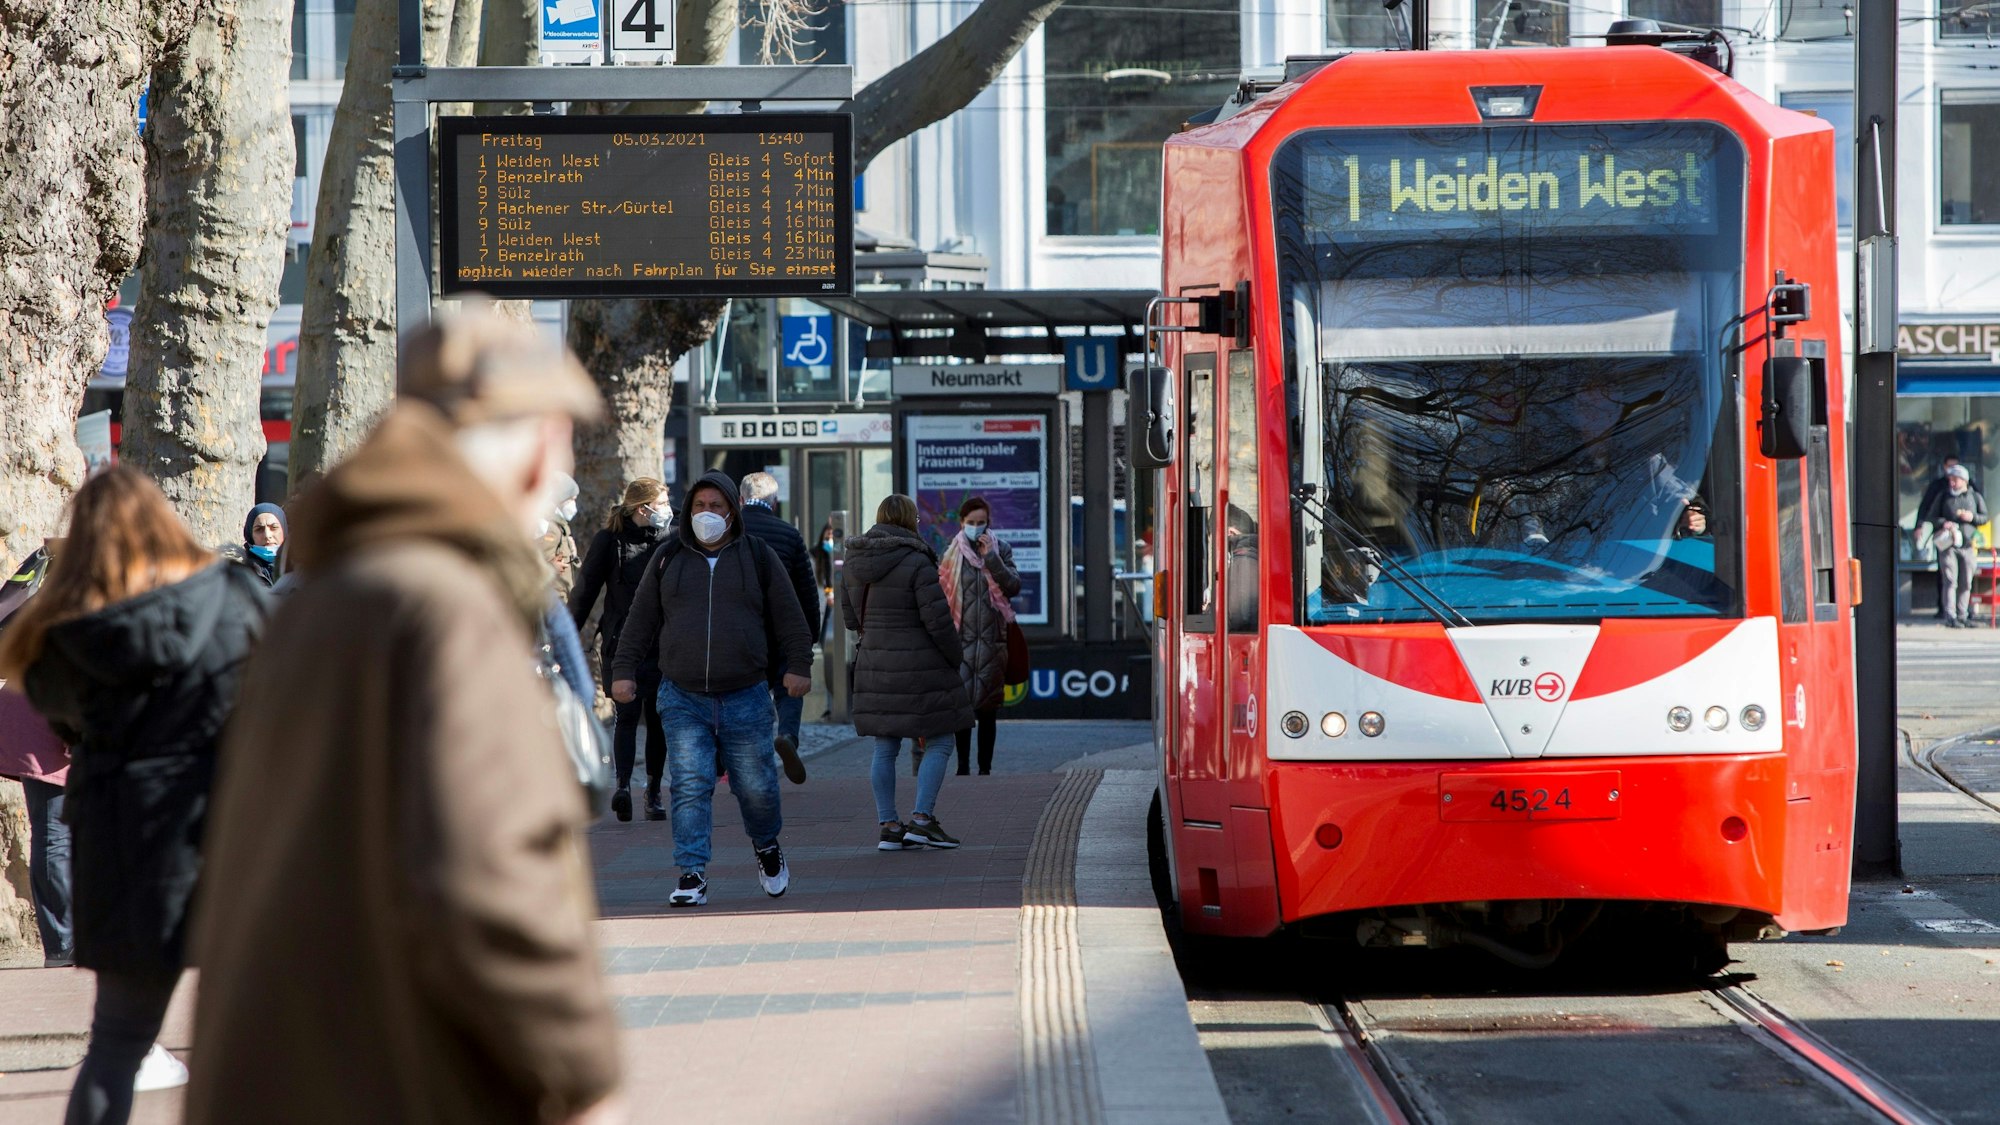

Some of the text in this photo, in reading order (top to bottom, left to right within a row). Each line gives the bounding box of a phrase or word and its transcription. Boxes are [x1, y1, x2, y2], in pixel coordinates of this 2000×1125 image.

[621, 0, 665, 43] 4
[482, 132, 804, 150] Freitag 05.03.2021 13:40
[479, 152, 835, 168] 1 Weiden West Gleis 4 Sofort
[477, 170, 487, 183] 7
[497, 170, 583, 183] Benzelrath
[709, 169, 750, 182] Gleis
[761, 169, 771, 181] 4
[478, 186, 488, 199] 9
[497, 186, 531, 199] Sülz
[709, 184, 750, 197] Gleis
[761, 184, 771, 196] 4
[1344, 152, 1702, 222] 1 Weiden West
[478, 201, 488, 215] 7
[498, 201, 570, 215] Aachener
[581, 201, 674, 215] Str./Gürtel
[709, 200, 750, 213] Gleis
[761, 200, 771, 212] 4
[478, 217, 488, 230] 9
[498, 217, 531, 230] Sülz
[709, 215, 750, 229] Gleis
[761, 215, 771, 228] 4
[480, 233, 486, 246] 1
[498, 233, 552, 246] Weiden
[563, 233, 601, 246] West
[710, 231, 750, 244] Gleis
[762, 231, 772, 243] 4
[479, 249, 488, 262] 7
[498, 249, 584, 262] Benzelrath
[710, 247, 750, 260] Gleis
[762, 247, 772, 259] 4
[523, 264, 575, 277] wieder
[586, 264, 622, 277] nach
[633, 263, 703, 279] Fahrplan
[715, 263, 739, 279] für
[750, 262, 776, 276] Sie
[786, 262, 836, 275] einset
[1076, 345, 1106, 383] U
[931, 370, 1023, 387] Neumarkt
[918, 442, 1018, 456] Internationaler
[918, 456, 984, 471] Frauentag
[1490, 679, 1532, 696] KVB
[1490, 788, 1572, 812] 4524
